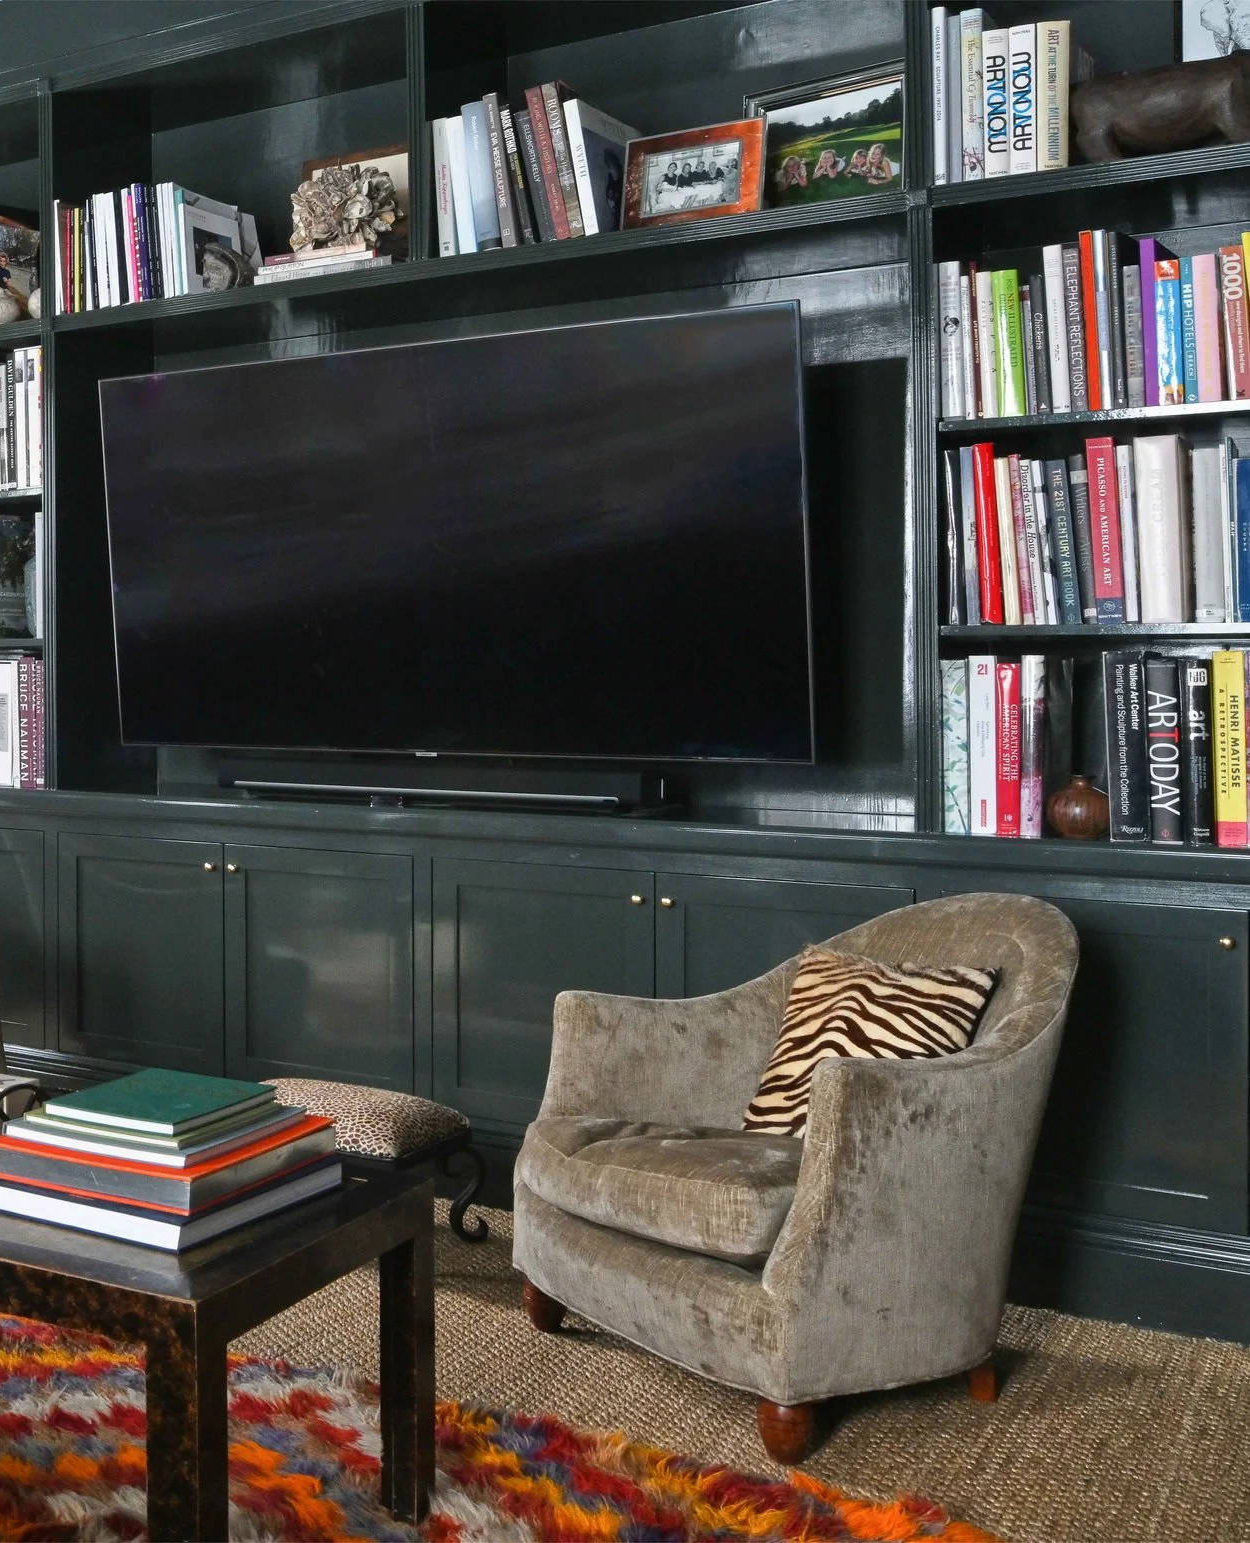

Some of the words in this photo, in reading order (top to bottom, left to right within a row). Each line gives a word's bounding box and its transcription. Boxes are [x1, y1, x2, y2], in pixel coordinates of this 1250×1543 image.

[967, 38, 976, 52] The
[1047, 29, 1060, 46] ART
[1048, 46, 1057, 55] AT
[968, 53, 977, 82] Essential
[1048, 54, 1057, 66] THE
[967, 85, 977, 93] Cy
[1048, 67, 1057, 84] TURN
[1048, 85, 1057, 94] OF
[1048, 95, 1057, 107] THE
[500, 110, 513, 130] MARK
[546, 98, 562, 135] ROOMS
[490, 132, 499, 147] EVA
[503, 129, 517, 154] ROTHKO
[1047, 107, 1060, 161] MILLENNIUM
[493, 147, 502, 169] HESSE
[523, 124, 536, 163] ELLSWORTH
[531, 163, 541, 182] KELLY
[542, 147, 552, 175] HISTORY
[575, 144, 587, 178] WYETH
[496, 169, 507, 208] SCULPTURE
[1222, 253, 1243, 300] 1000
[1007, 292, 1015, 311] NEW
[1066, 266, 1081, 321] ELEPHANT
[1183, 283, 1193, 309] HIP
[1008, 312, 1018, 368] ILLUSTRATED
[1033, 313, 1043, 350] Chickens
[1183, 310, 1195, 348] HOTELS
[1070, 325, 1084, 397] REFLECTIONS
[7, 385, 15, 417] GULDEN
[1053, 469, 1063, 486] THE
[1096, 457, 1107, 497] PICASSO
[1025, 504, 1034, 513] in
[1054, 490, 1065, 512] 21ST
[1074, 487, 1087, 525] Writers
[1026, 515, 1035, 529] the
[1027, 532, 1037, 559] House
[1058, 516, 1069, 557] CENTURY
[1100, 514, 1110, 565] AMERICAN
[1062, 561, 1072, 578] ART
[1080, 541, 1091, 572] Artists
[1103, 567, 1112, 585] ART
[1064, 581, 1075, 607] BOOK
[19, 664, 28, 712] BRUCE
[1114, 664, 1125, 694] Painting
[1129, 663, 1138, 690] Walker
[1116, 695, 1126, 709] and
[1130, 691, 1139, 703] Art
[1002, 704, 1010, 750] AMERICAN
[1131, 704, 1140, 730] Center
[1189, 710, 1209, 741] art
[1230, 695, 1240, 732] HENRI
[1010, 704, 1018, 761] CELEBRATING
[1117, 710, 1128, 746] Sculpture
[20, 719, 29, 781] NAUMAN
[1119, 746, 1128, 765] from
[1147, 690, 1181, 816] ARTODAY
[1230, 737, 1241, 788] MATISSE
[1002, 753, 1010, 782] SPIRIT
[1010, 763, 1018, 781] THE
[1119, 765, 1129, 778] the
[1120, 778, 1130, 815] Collection
